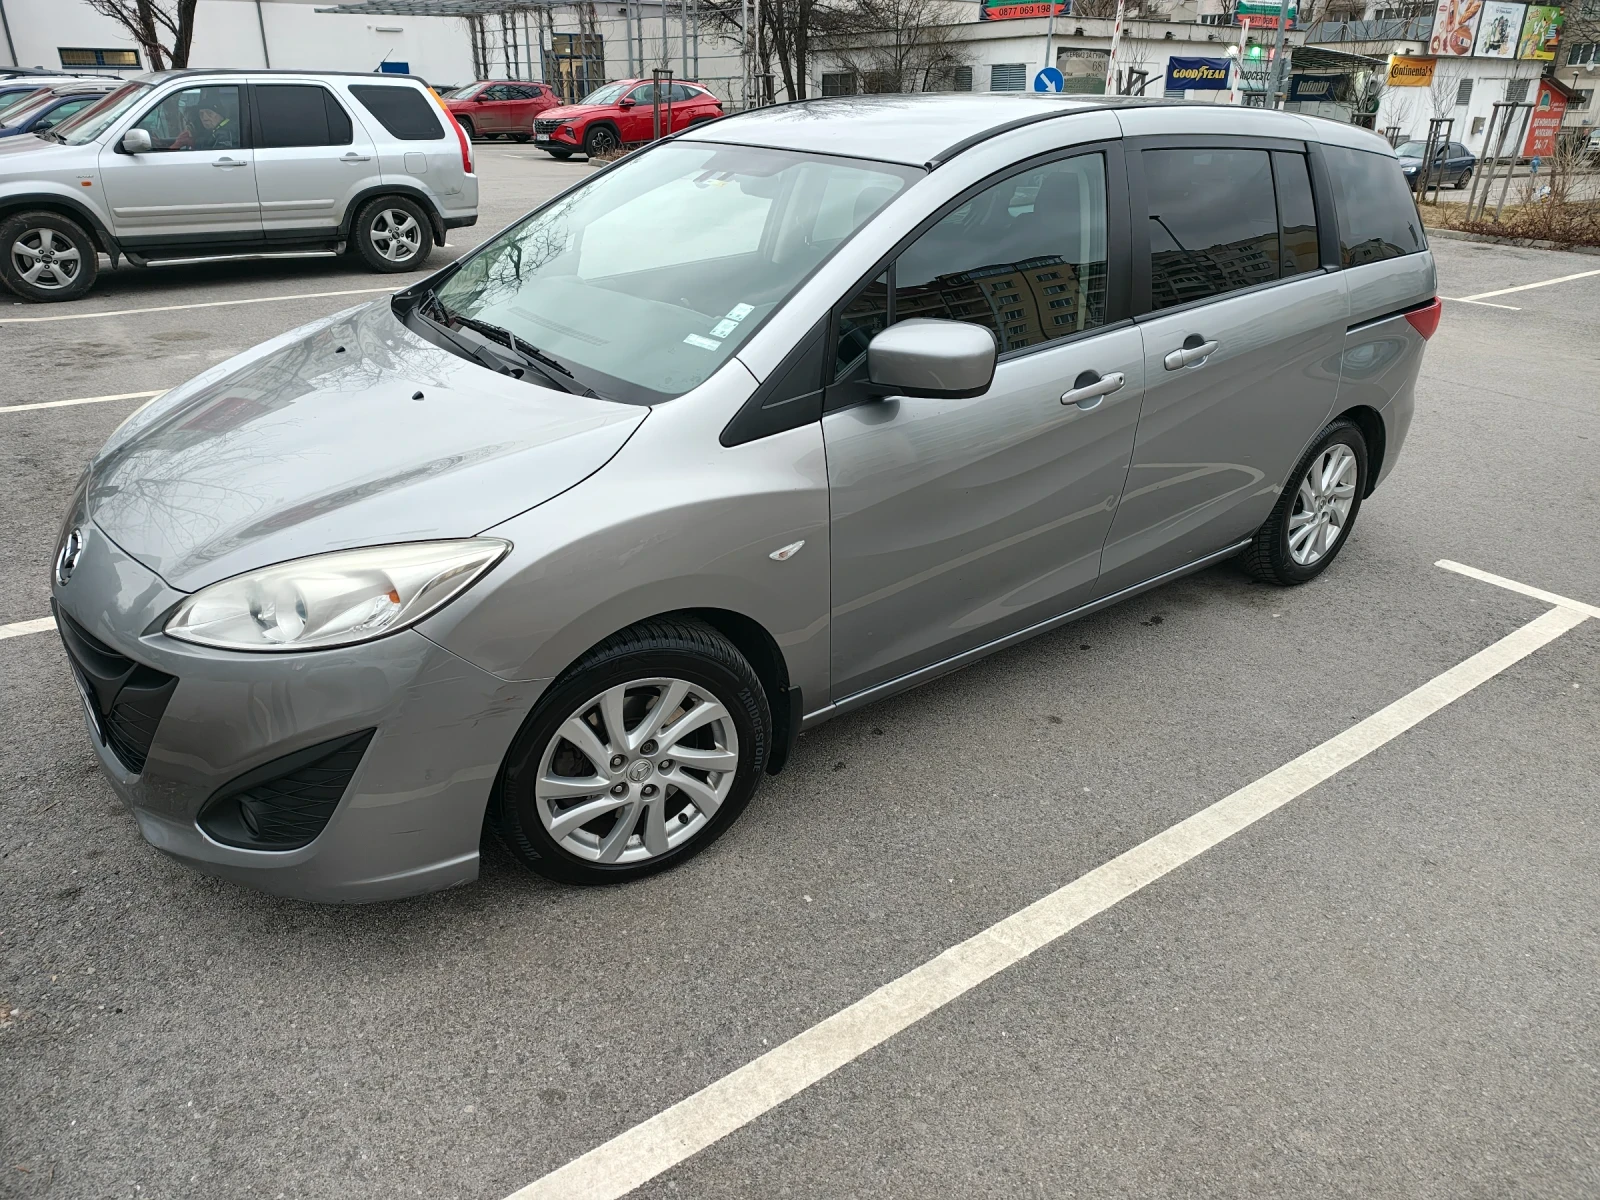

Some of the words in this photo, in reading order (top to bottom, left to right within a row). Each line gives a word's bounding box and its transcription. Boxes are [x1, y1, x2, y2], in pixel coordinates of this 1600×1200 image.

[998, 7, 1017, 16] 0877
[1020, 5, 1034, 15] 069
[1036, 4, 1051, 13] 198
[1172, 66, 1226, 80] GOODYEAR
[1391, 64, 1428, 78] Continental
[1298, 79, 1330, 94] Infinity
[737, 687, 764, 772] BRIDGESTONE
